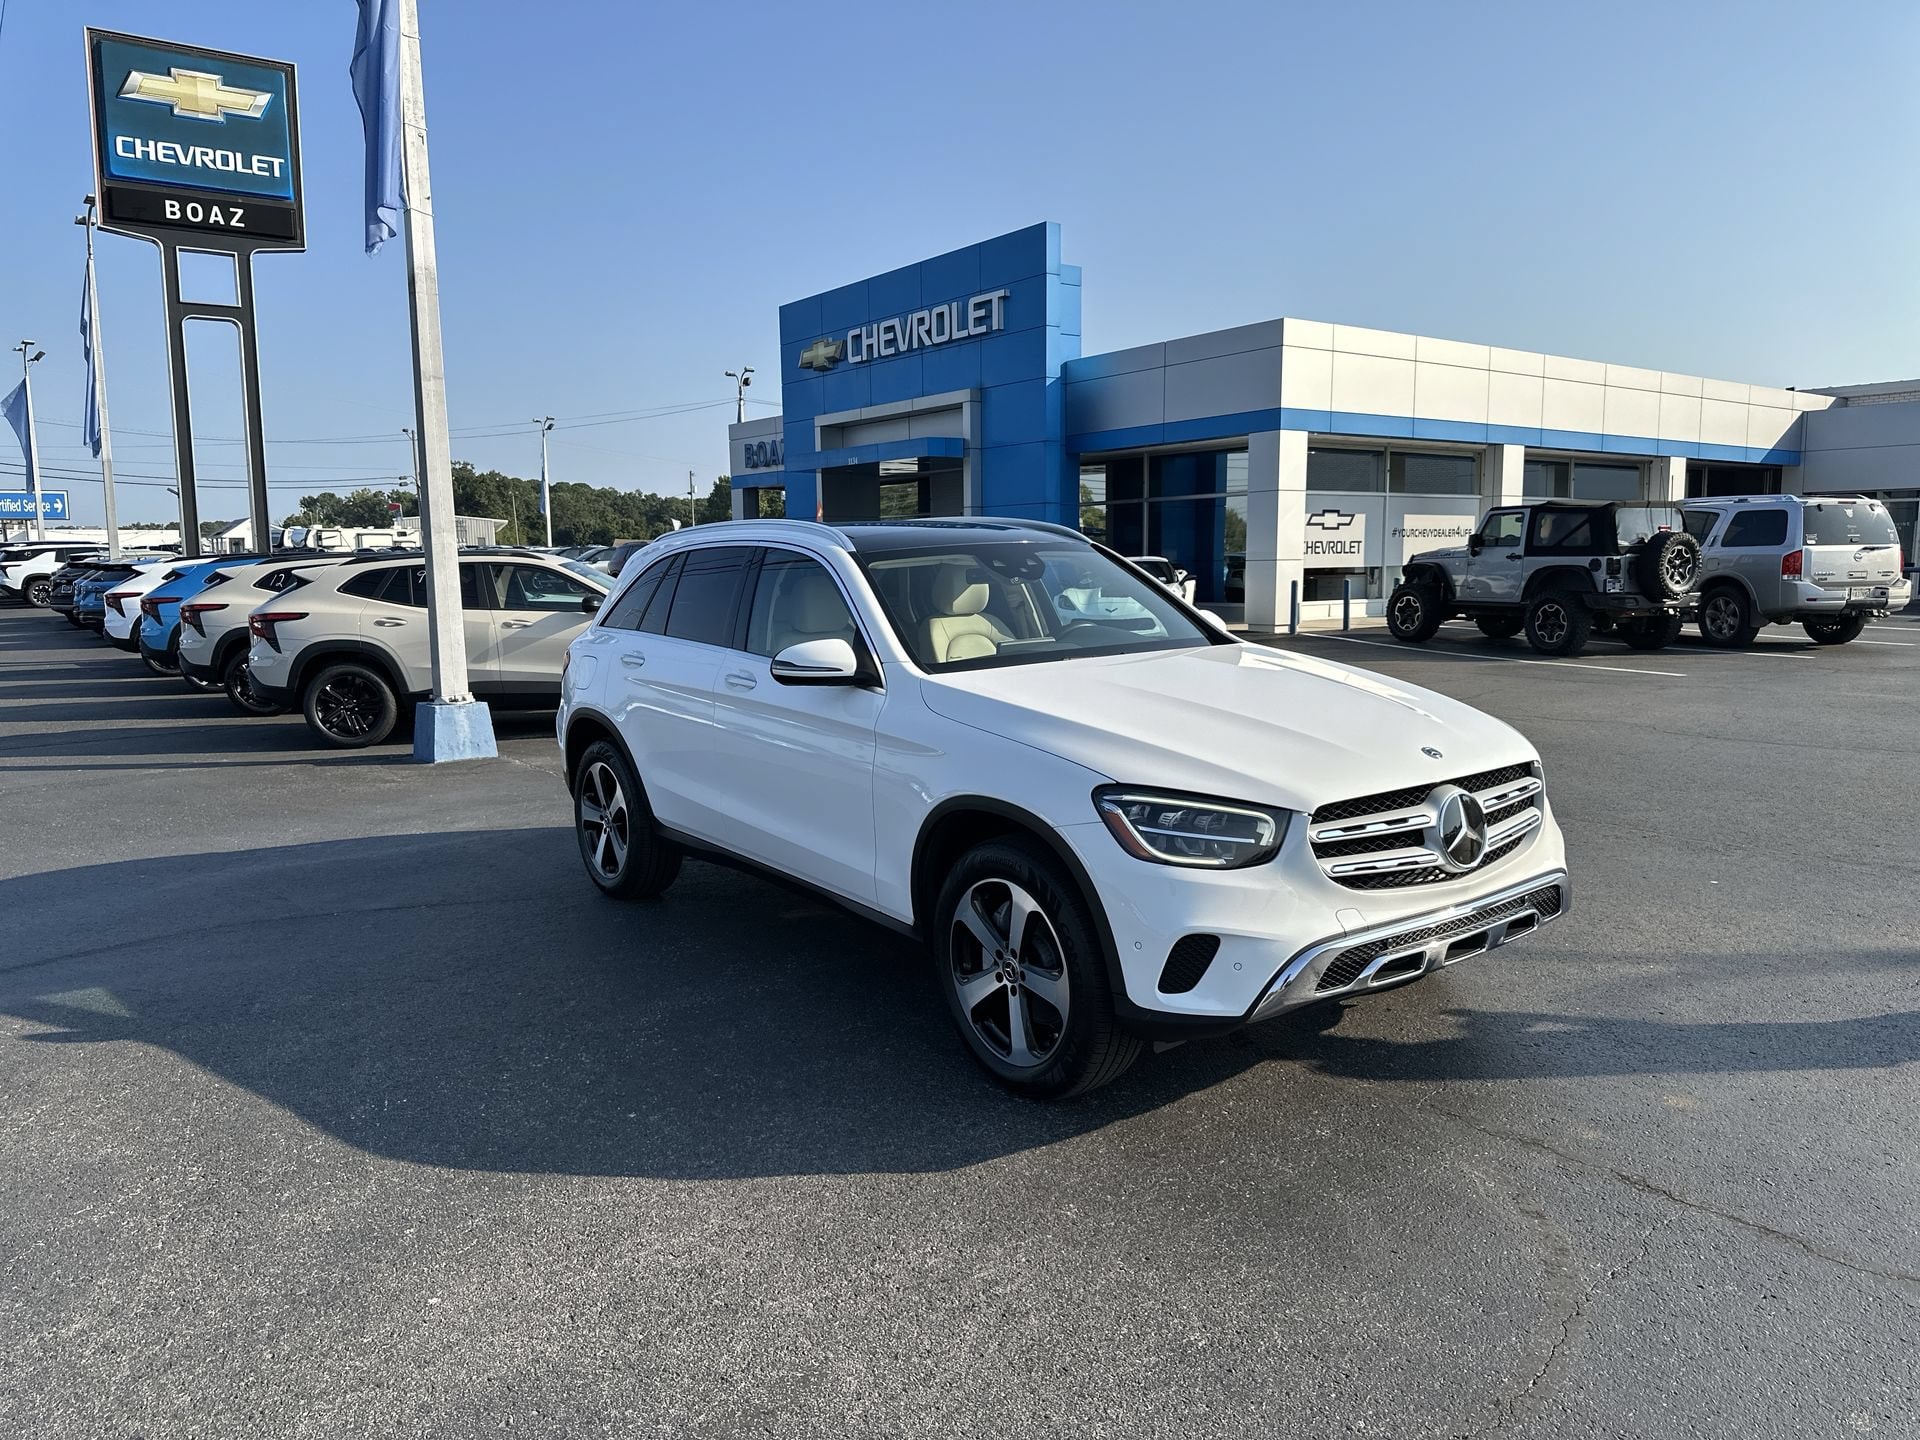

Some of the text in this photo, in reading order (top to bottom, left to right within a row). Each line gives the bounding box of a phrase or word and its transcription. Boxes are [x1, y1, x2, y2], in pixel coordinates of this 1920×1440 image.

[115, 135, 285, 178] CHEVROLET
[164, 199, 246, 228] BOAZ
[847, 288, 1010, 364] CHEVROLET
[23, 499, 51, 512] Serce
[1303, 540, 1363, 555] HEVROLET
[270, 573, 285, 588] 12
